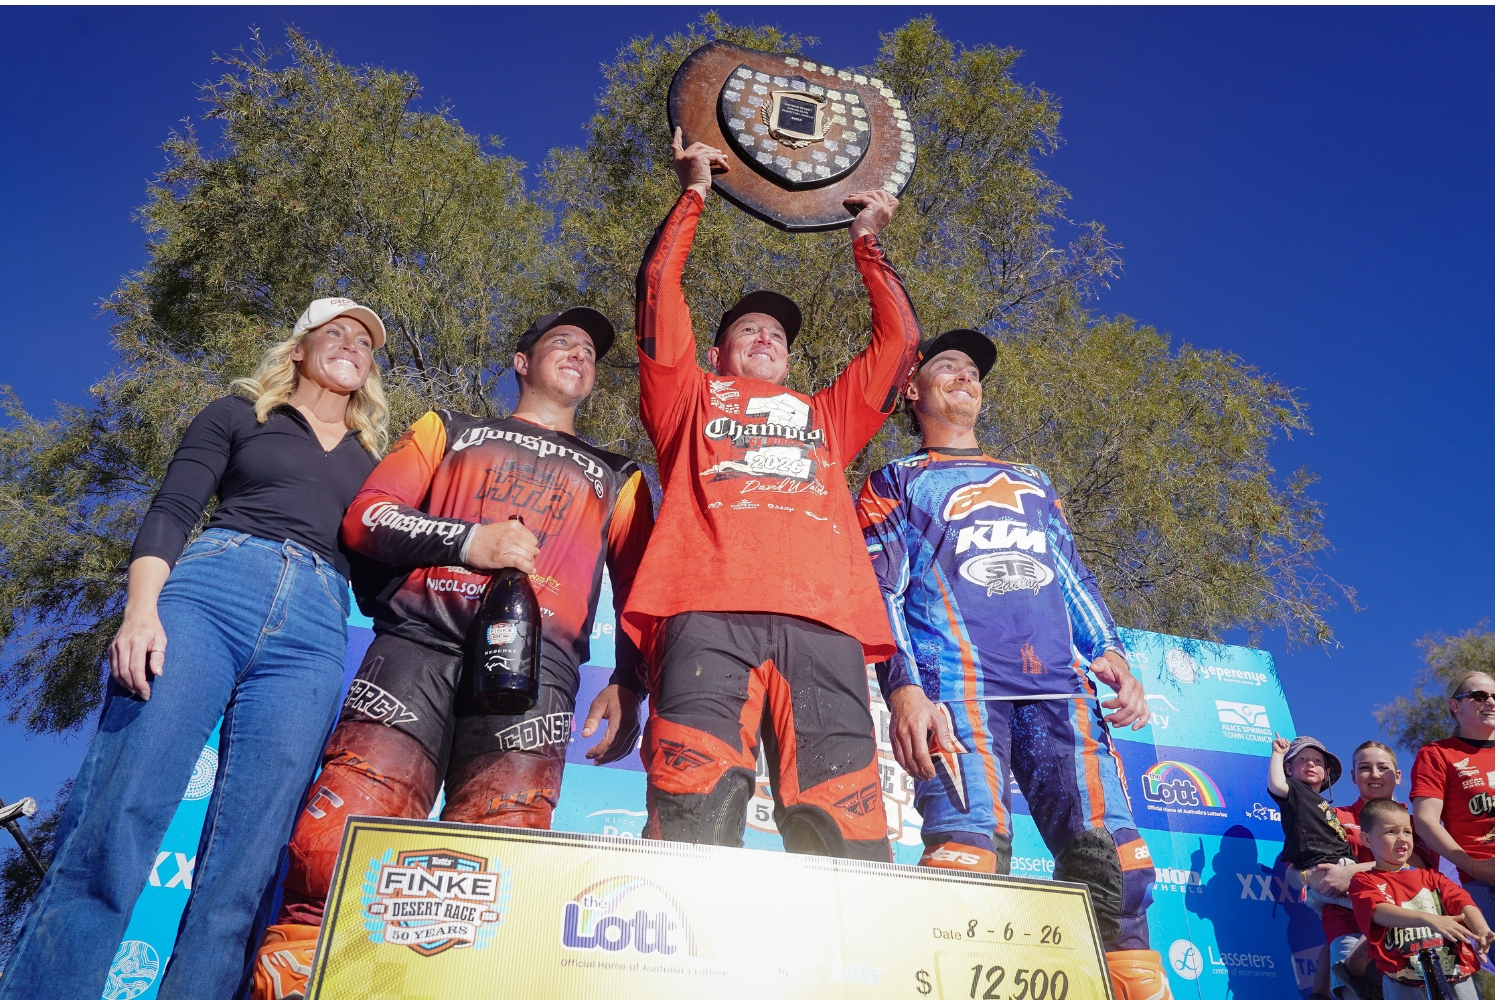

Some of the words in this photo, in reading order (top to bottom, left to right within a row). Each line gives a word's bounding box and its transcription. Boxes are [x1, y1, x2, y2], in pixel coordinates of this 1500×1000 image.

[750, 454, 804, 473] 2026
[955, 519, 1047, 555] KTM
[983, 559, 1037, 579] STE
[426, 577, 488, 596] NICOLSON
[985, 575, 1041, 597] Racing
[1200, 664, 1268, 687] yeperenye
[1222, 723, 1242, 733] ALICE
[1243, 725, 1273, 735] SPRINGS
[1222, 730, 1245, 740] TOWN
[1245, 733, 1273, 744] COUNCI
[1142, 775, 1199, 807] Lott
[432, 857, 454, 866] Tatts
[385, 871, 492, 896] FINKE
[392, 902, 442, 917] DESERT
[444, 903, 477, 922] RACE
[583, 895, 608, 910] the
[392, 930, 410, 941] 50
[414, 925, 468, 940] YEARS
[562, 903, 678, 955] Lott
[932, 927, 962, 941] Date
[966, 918, 978, 938] 8
[1003, 921, 1014, 941] 6
[1040, 924, 1062, 945] 26
[560, 958, 595, 969] Official
[597, 960, 626, 971] Home
[629, 962, 640, 972] of
[1208, 946, 1275, 969] Lasseters
[914, 968, 932, 997] $
